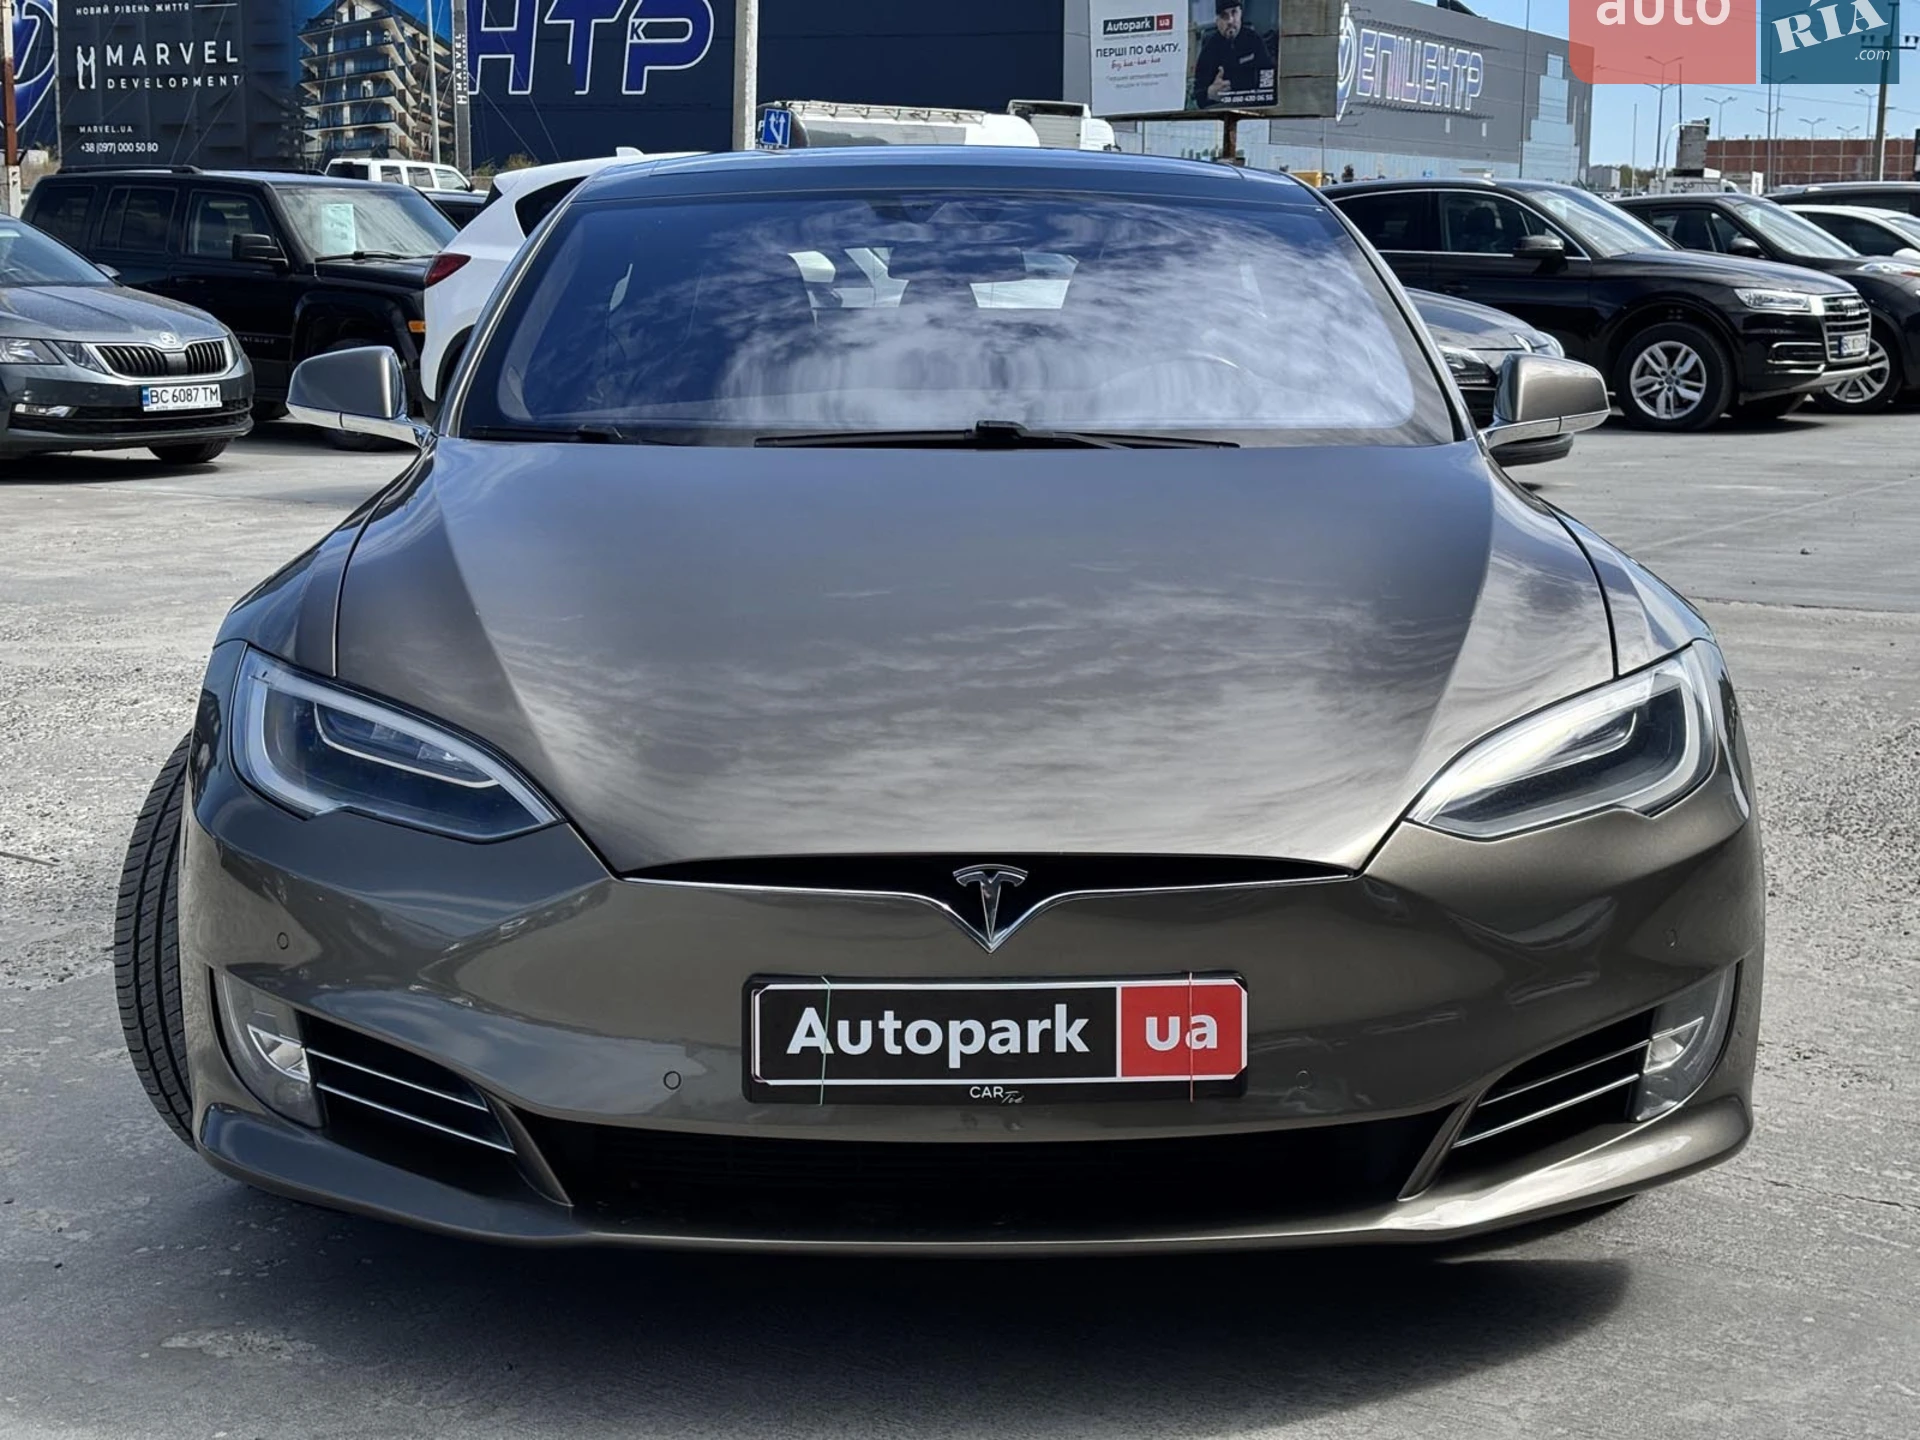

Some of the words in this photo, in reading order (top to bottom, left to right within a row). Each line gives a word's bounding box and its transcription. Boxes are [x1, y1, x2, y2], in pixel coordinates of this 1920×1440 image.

[76, 4, 110, 16] НОВИЙ
[114, 4, 150, 14] РІВЕНЬ
[155, 2, 190, 13] ЖИТТЯ
[1105, 17, 1151, 32] Autopark
[1159, 18, 1170, 27] ua
[106, 40, 239, 67] MARVEL
[1096, 46, 1127, 58] ПЕРШІ
[1129, 46, 1144, 56] ПО
[1145, 42, 1181, 54] ФАКТУ.
[1356, 28, 1484, 111] ЕПІЦЕНТР
[107, 75, 239, 89] DEVELOPMENT
[79, 125, 133, 133] MARVEL.UA
[80, 142, 95, 153] +38
[96, 142, 116, 155] (097)
[117, 142, 134, 153] 000
[135, 142, 146, 153] 50
[147, 142, 159, 153] 80
[149, 389, 169, 404] BC
[171, 387, 199, 403] 6087
[201, 386, 219, 402] TM
[786, 1003, 1090, 1069] Autopark
[1145, 1014, 1218, 1052] ua
[969, 1085, 1004, 1099] CAR
